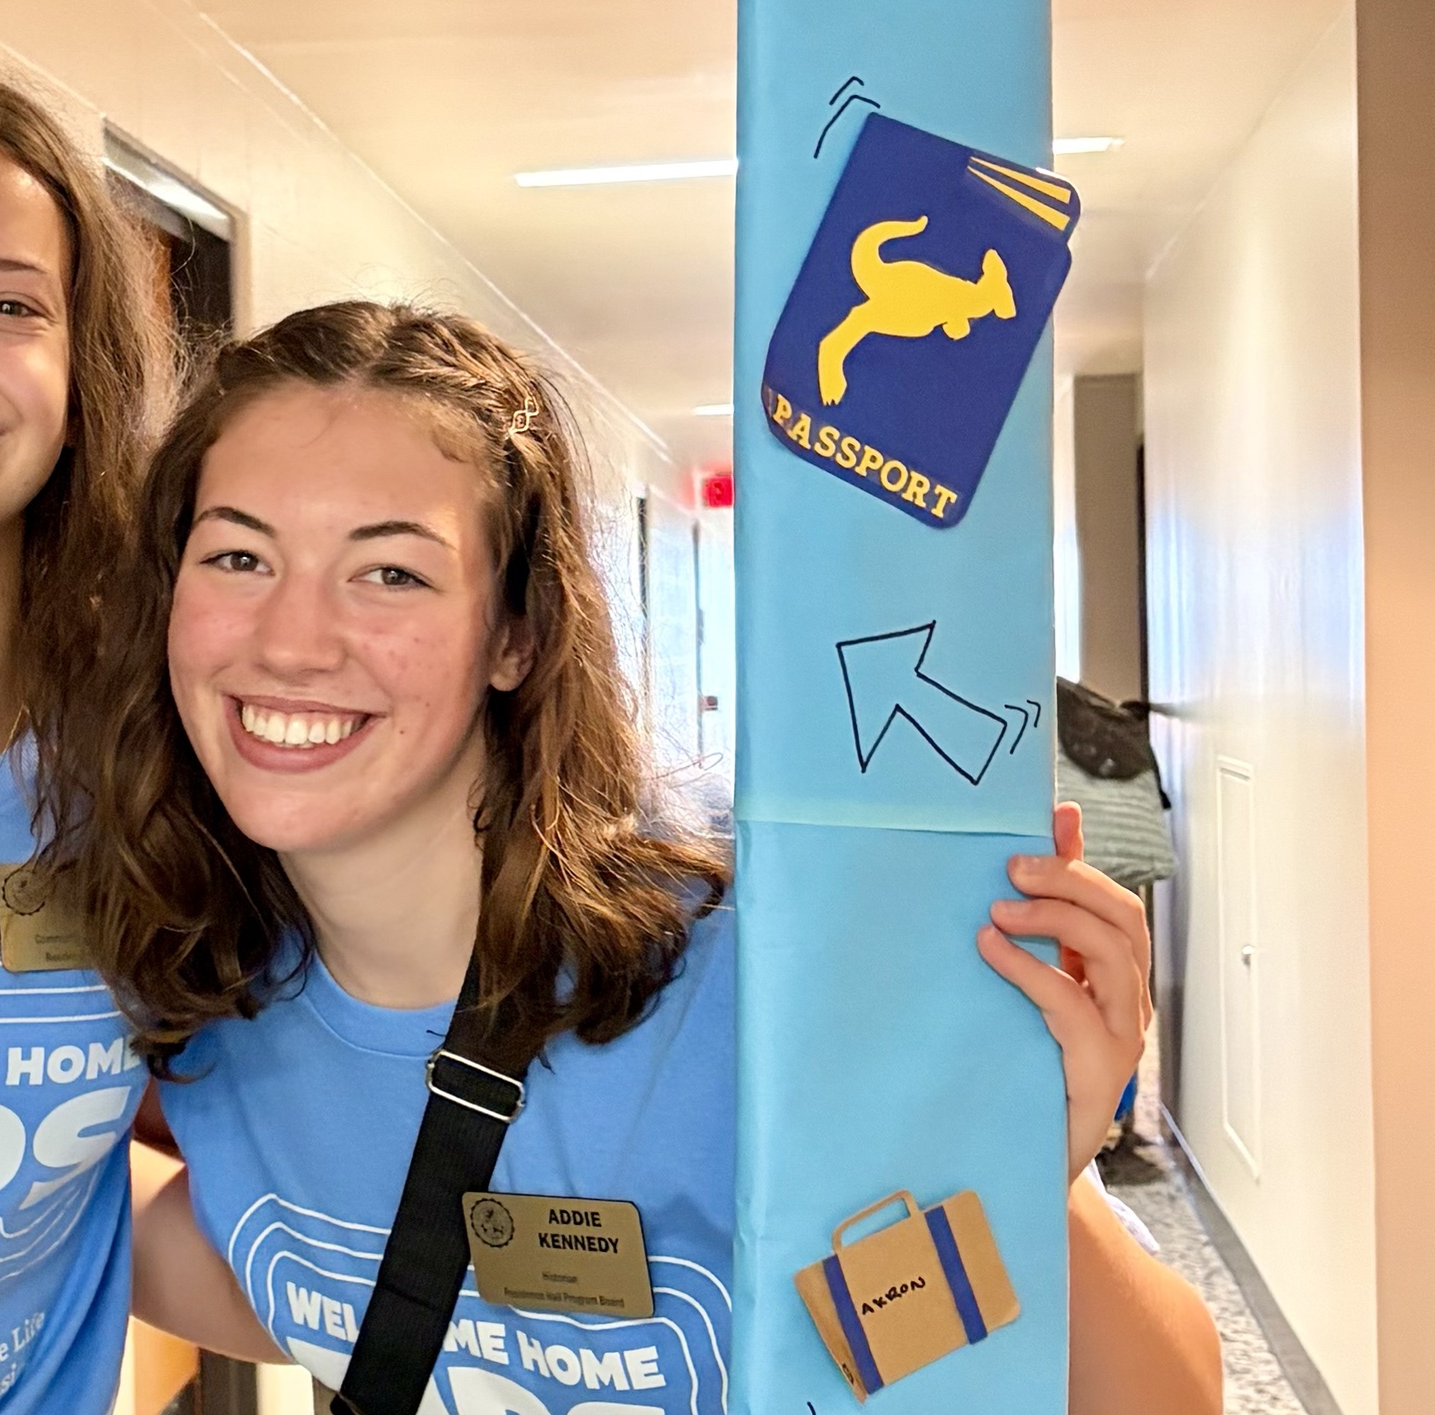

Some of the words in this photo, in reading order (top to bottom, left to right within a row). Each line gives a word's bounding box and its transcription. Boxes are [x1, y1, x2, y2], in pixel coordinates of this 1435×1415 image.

[772, 393, 958, 519] PASSPORT
[548, 1208, 602, 1228] ADDIE
[538, 1232, 619, 1254] KENNEDY
[861, 1276, 926, 1316] AKRON
[11, 1311, 46, 1353] Life
[286, 1281, 509, 1365] WELME
[516, 1330, 667, 1391] HOME
